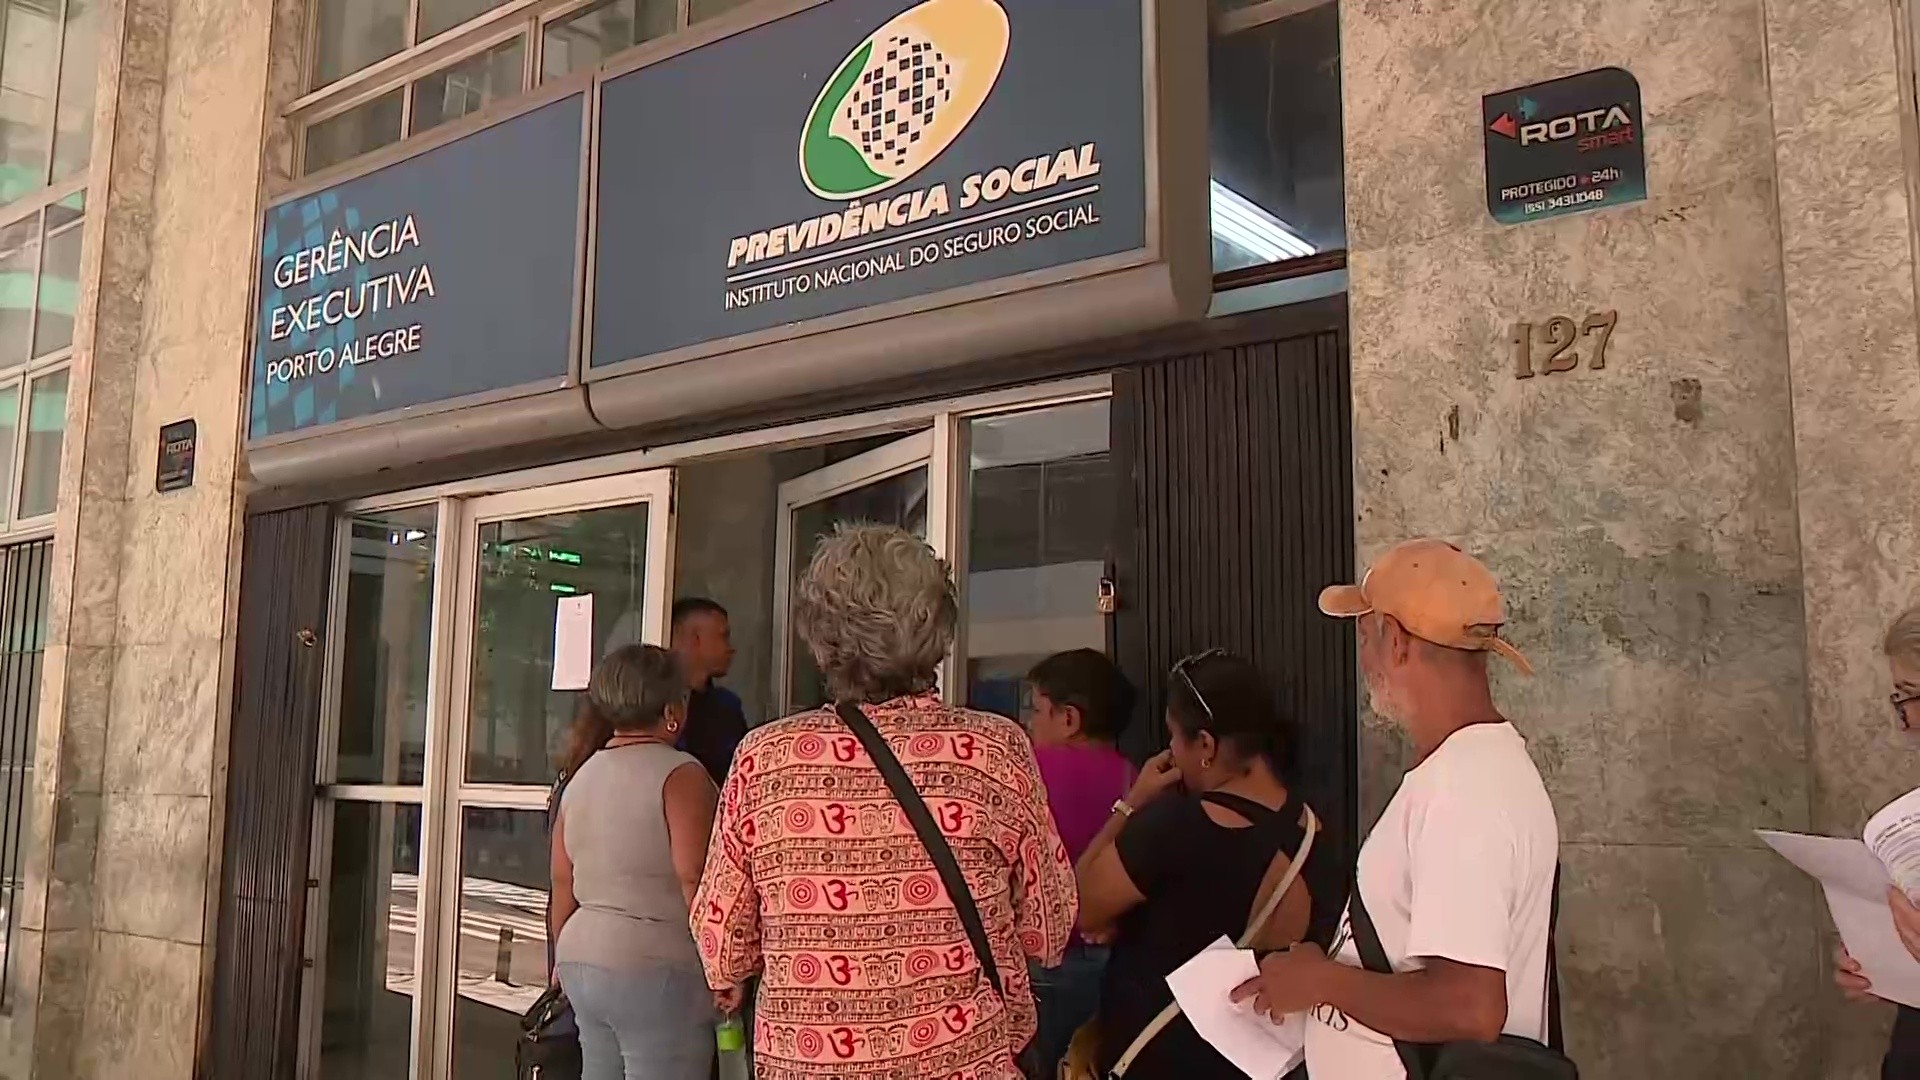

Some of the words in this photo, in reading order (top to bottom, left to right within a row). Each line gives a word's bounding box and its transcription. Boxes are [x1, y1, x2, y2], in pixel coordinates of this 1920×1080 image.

[1520, 106, 1632, 147] ROTA
[727, 182, 950, 268] PREVIDÊNCIA
[959, 142, 1100, 208] SOCIAL
[1501, 174, 1578, 201] PROTEGIDO
[1591, 167, 1619, 183] 24h
[274, 213, 420, 289] GERÊNCIA
[725, 275, 811, 310] INSTITUTO
[814, 252, 906, 290] NACIONAL
[910, 243, 940, 267] DO
[944, 222, 1021, 259] SEGURO
[1025, 203, 1100, 239] SOCIAL
[270, 264, 436, 341] EXECUTIVA
[266, 347, 335, 385] PORTO
[338, 324, 422, 369] ALEGRE
[1509, 309, 1617, 380] 127
